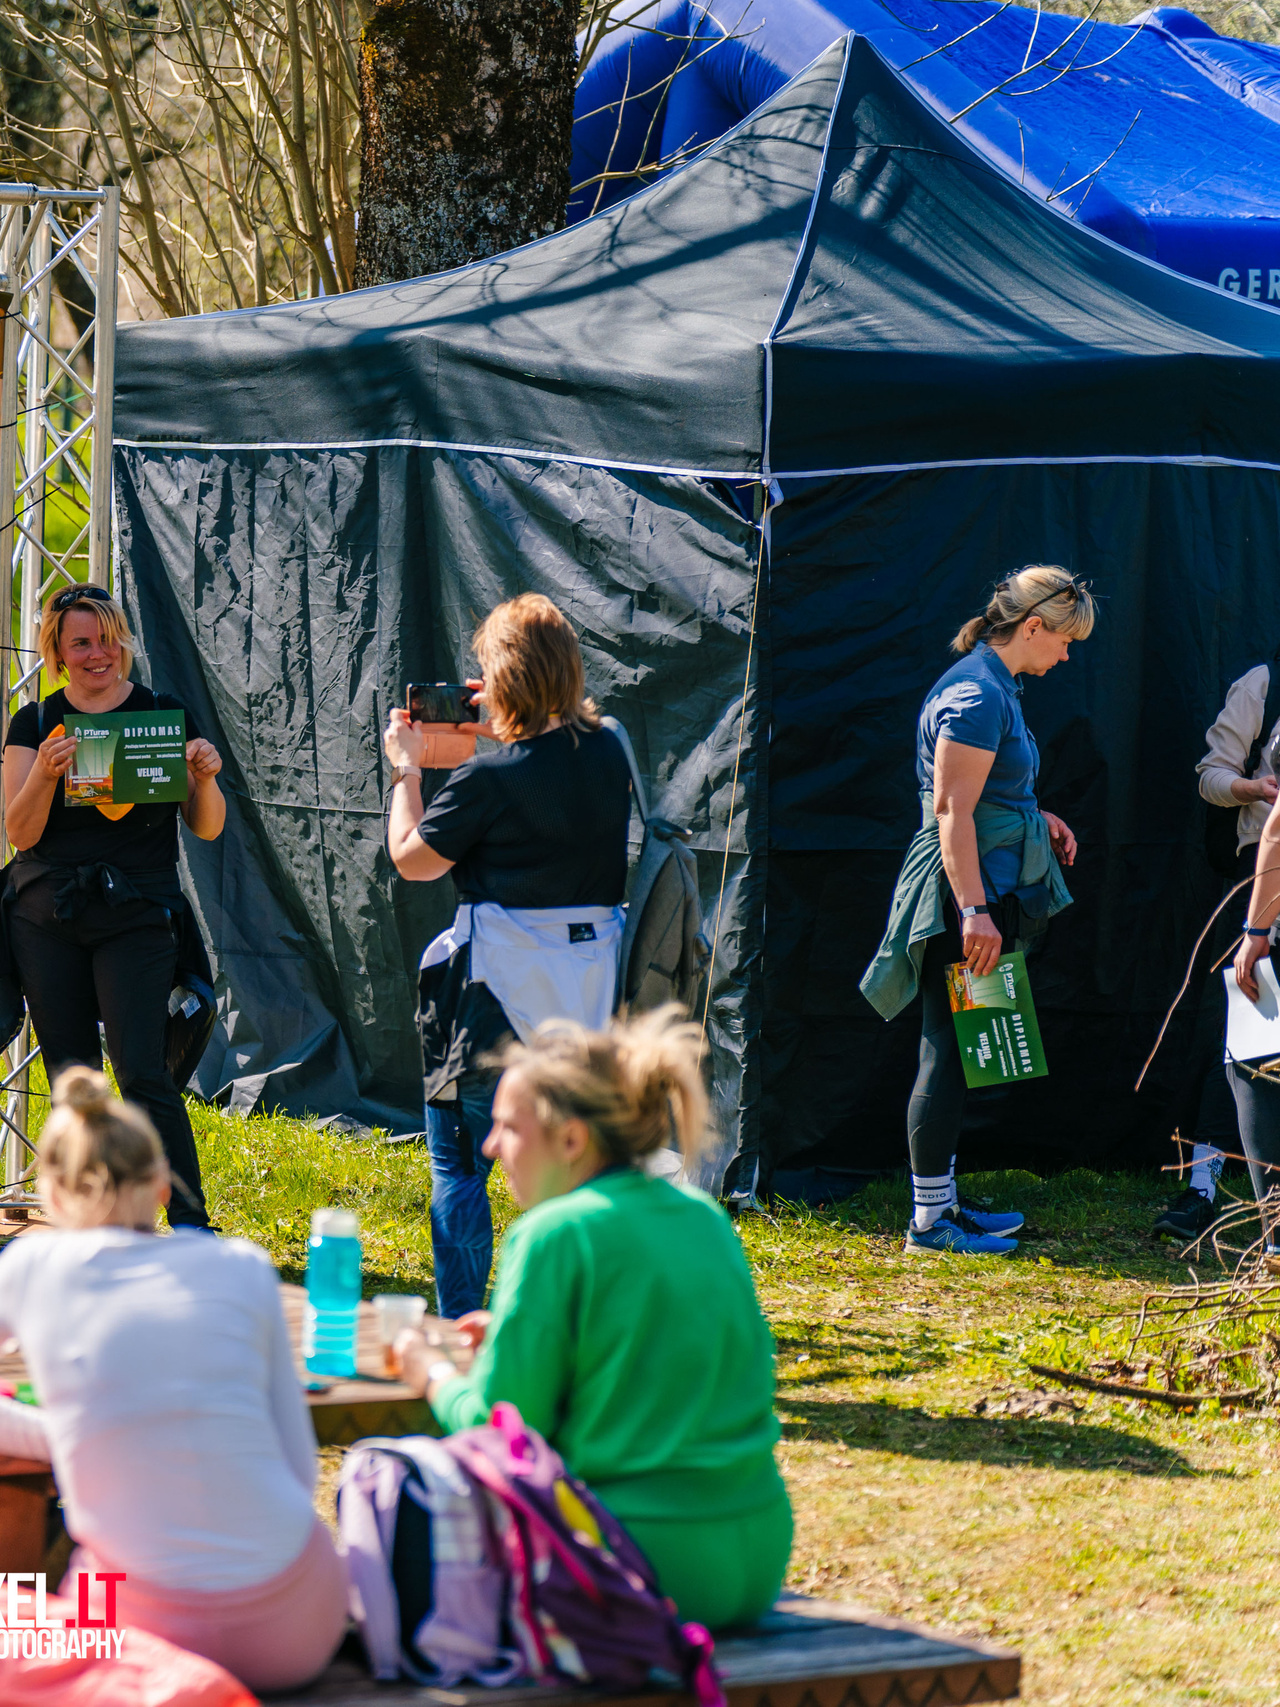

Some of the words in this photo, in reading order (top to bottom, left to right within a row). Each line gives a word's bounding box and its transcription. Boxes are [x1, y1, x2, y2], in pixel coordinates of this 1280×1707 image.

[84, 728, 109, 736] PTuras
[124, 725, 181, 738] DIPLOMAS
[136, 767, 164, 778] VELNIO
[1011, 1013, 1033, 1073] DIPLOMAS
